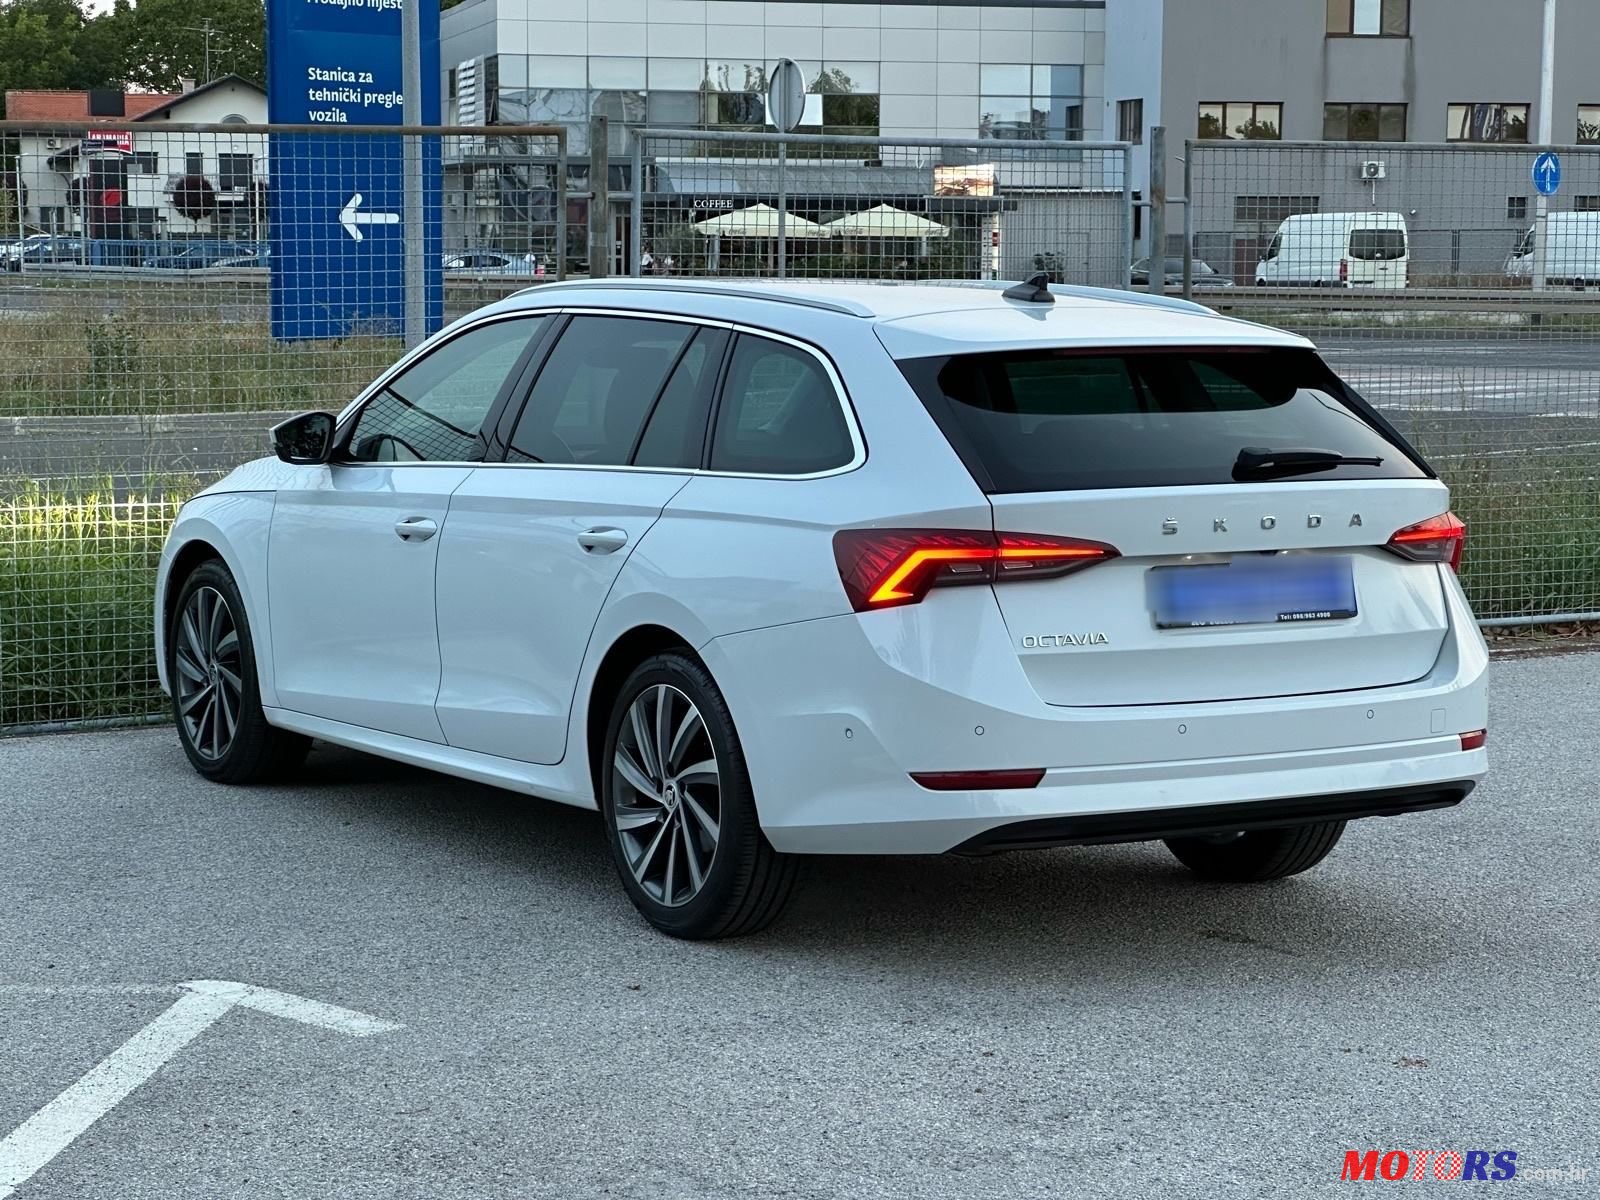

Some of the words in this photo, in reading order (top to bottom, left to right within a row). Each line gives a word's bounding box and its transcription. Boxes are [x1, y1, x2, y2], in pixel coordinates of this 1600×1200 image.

[307, 0, 363, 9] ajno
[367, 0, 402, 12] mjest
[308, 67, 355, 82] Stanica
[358, 72, 373, 83] za
[309, 88, 361, 103] tehnički
[364, 91, 403, 108] pregle
[309, 108, 347, 123] vozila
[694, 199, 733, 208] COFFEE
[1162, 513, 1363, 535] ŠKODA
[1022, 632, 1109, 648] OCTAVIA
